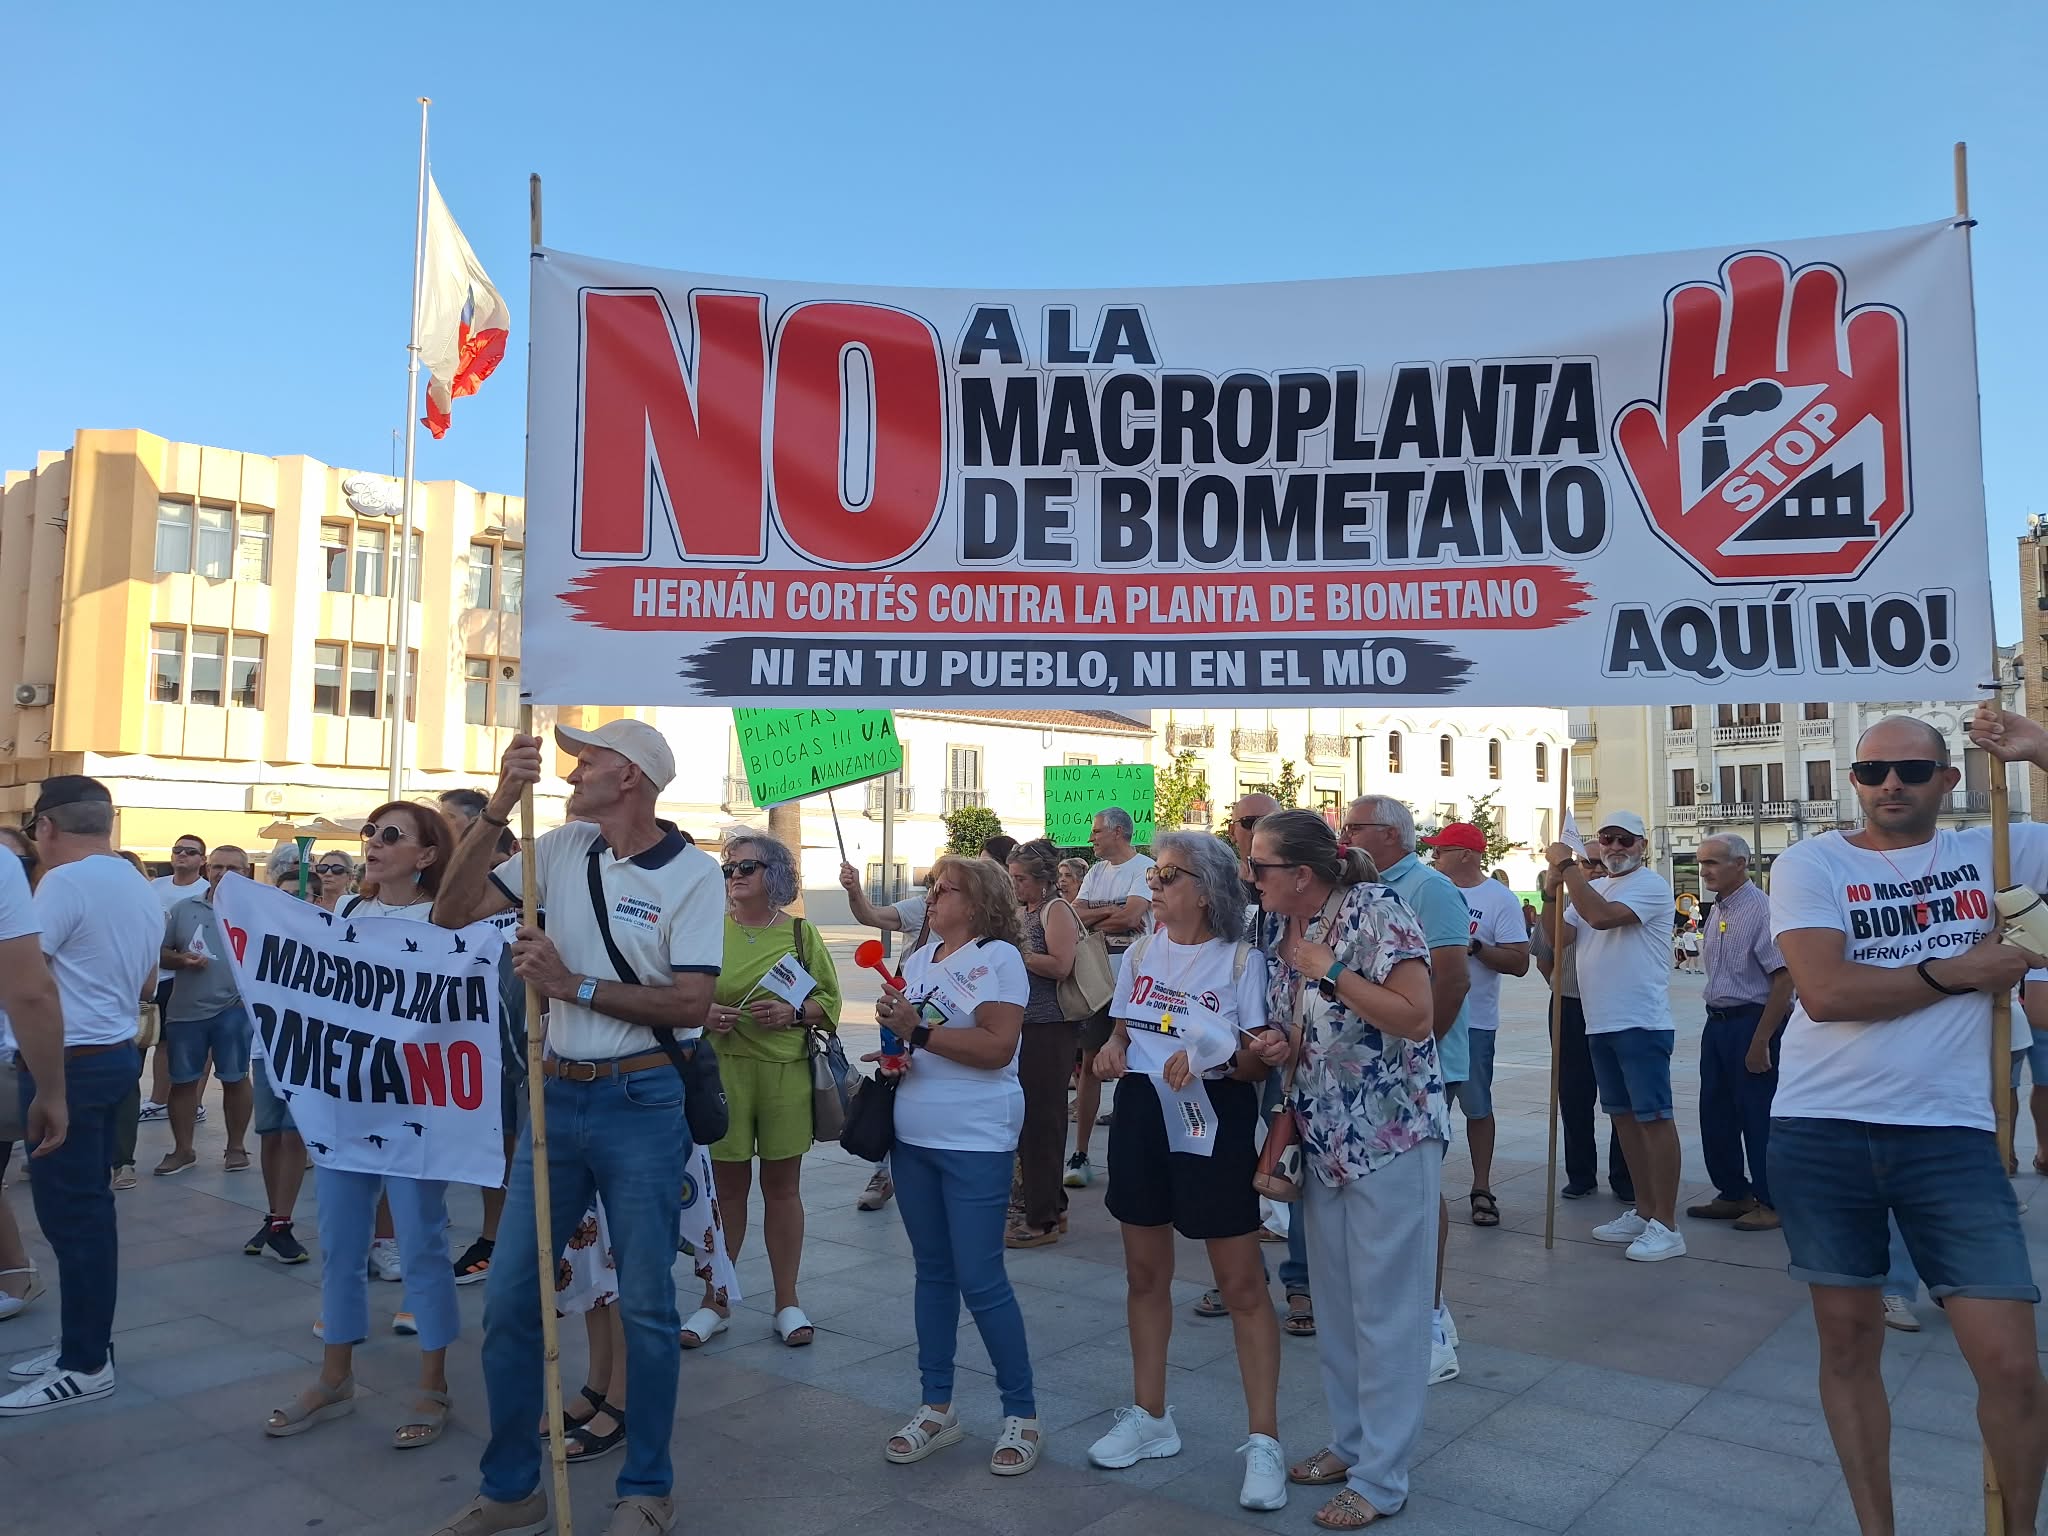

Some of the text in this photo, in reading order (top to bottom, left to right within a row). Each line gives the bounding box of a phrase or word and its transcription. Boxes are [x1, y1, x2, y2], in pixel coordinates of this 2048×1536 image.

[959, 307, 1157, 366] A LA
[576, 288, 945, 567] NO
[961, 362, 1600, 467] MACROPLANTA
[1721, 402, 1839, 512] STOP
[963, 465, 1607, 563] DE BIOMETANO
[633, 571, 1538, 624] HERNÁN CORTÉS CONTRA LA PLANTA DE BIOMETANO
[1608, 588, 1952, 680] AQUÍ NO!
[750, 640, 1407, 694] NI EN TU PUEBLO, NI EN EL MÍO
[744, 708, 836, 746] PLANTAS
[750, 737, 823, 774] BIOGAS
[756, 746, 898, 801] Unidas AVANZAMOS
[1091, 768, 1101, 780] A
[1116, 767, 1142, 780] LAS
[1044, 788, 1151, 803] PLANTAS DE
[1045, 812, 1093, 827] BIOGA
[615, 903, 659, 924] BIOMETANO
[1846, 883, 1872, 903] NO
[255, 933, 490, 1024] MACROPLANTA
[1153, 1000, 1168, 1011] DON
[1168, 1003, 1189, 1016] BENIT
